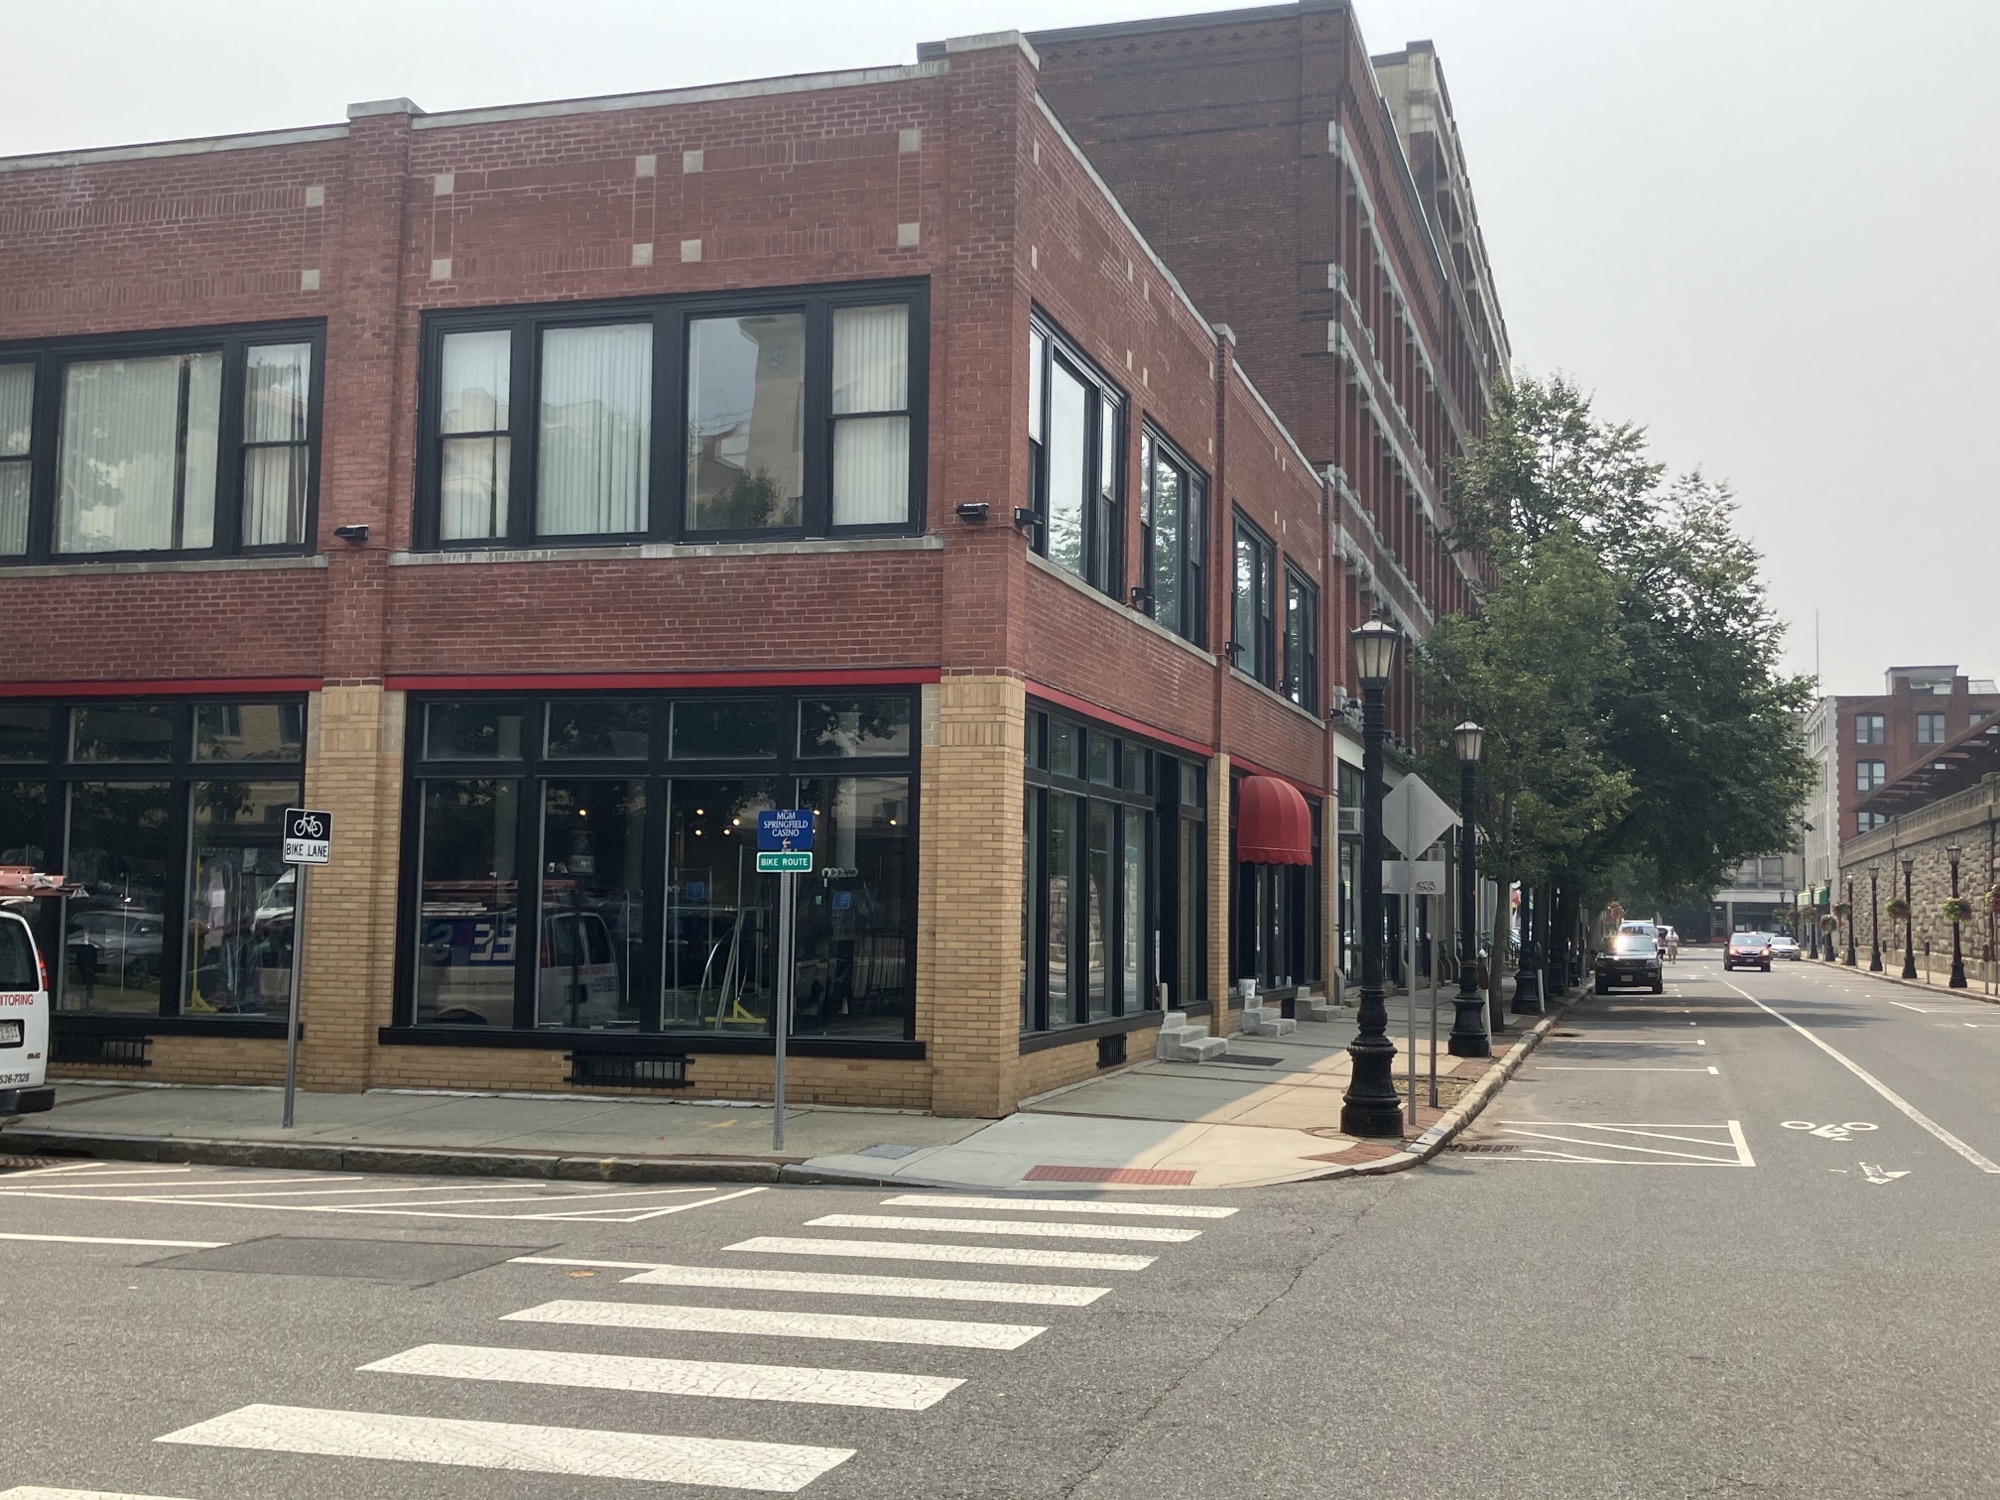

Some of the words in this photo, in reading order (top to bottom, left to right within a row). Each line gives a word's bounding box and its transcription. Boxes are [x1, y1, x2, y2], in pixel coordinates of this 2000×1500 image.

[776, 812, 796, 820] MGM
[763, 820, 809, 829] SPRINGFIELD
[771, 829, 800, 837] CASINO
[286, 843, 304, 857] BIKE
[306, 844, 328, 858] LANE
[760, 857, 779, 867] BIKE
[782, 857, 809, 867] ROUTE
